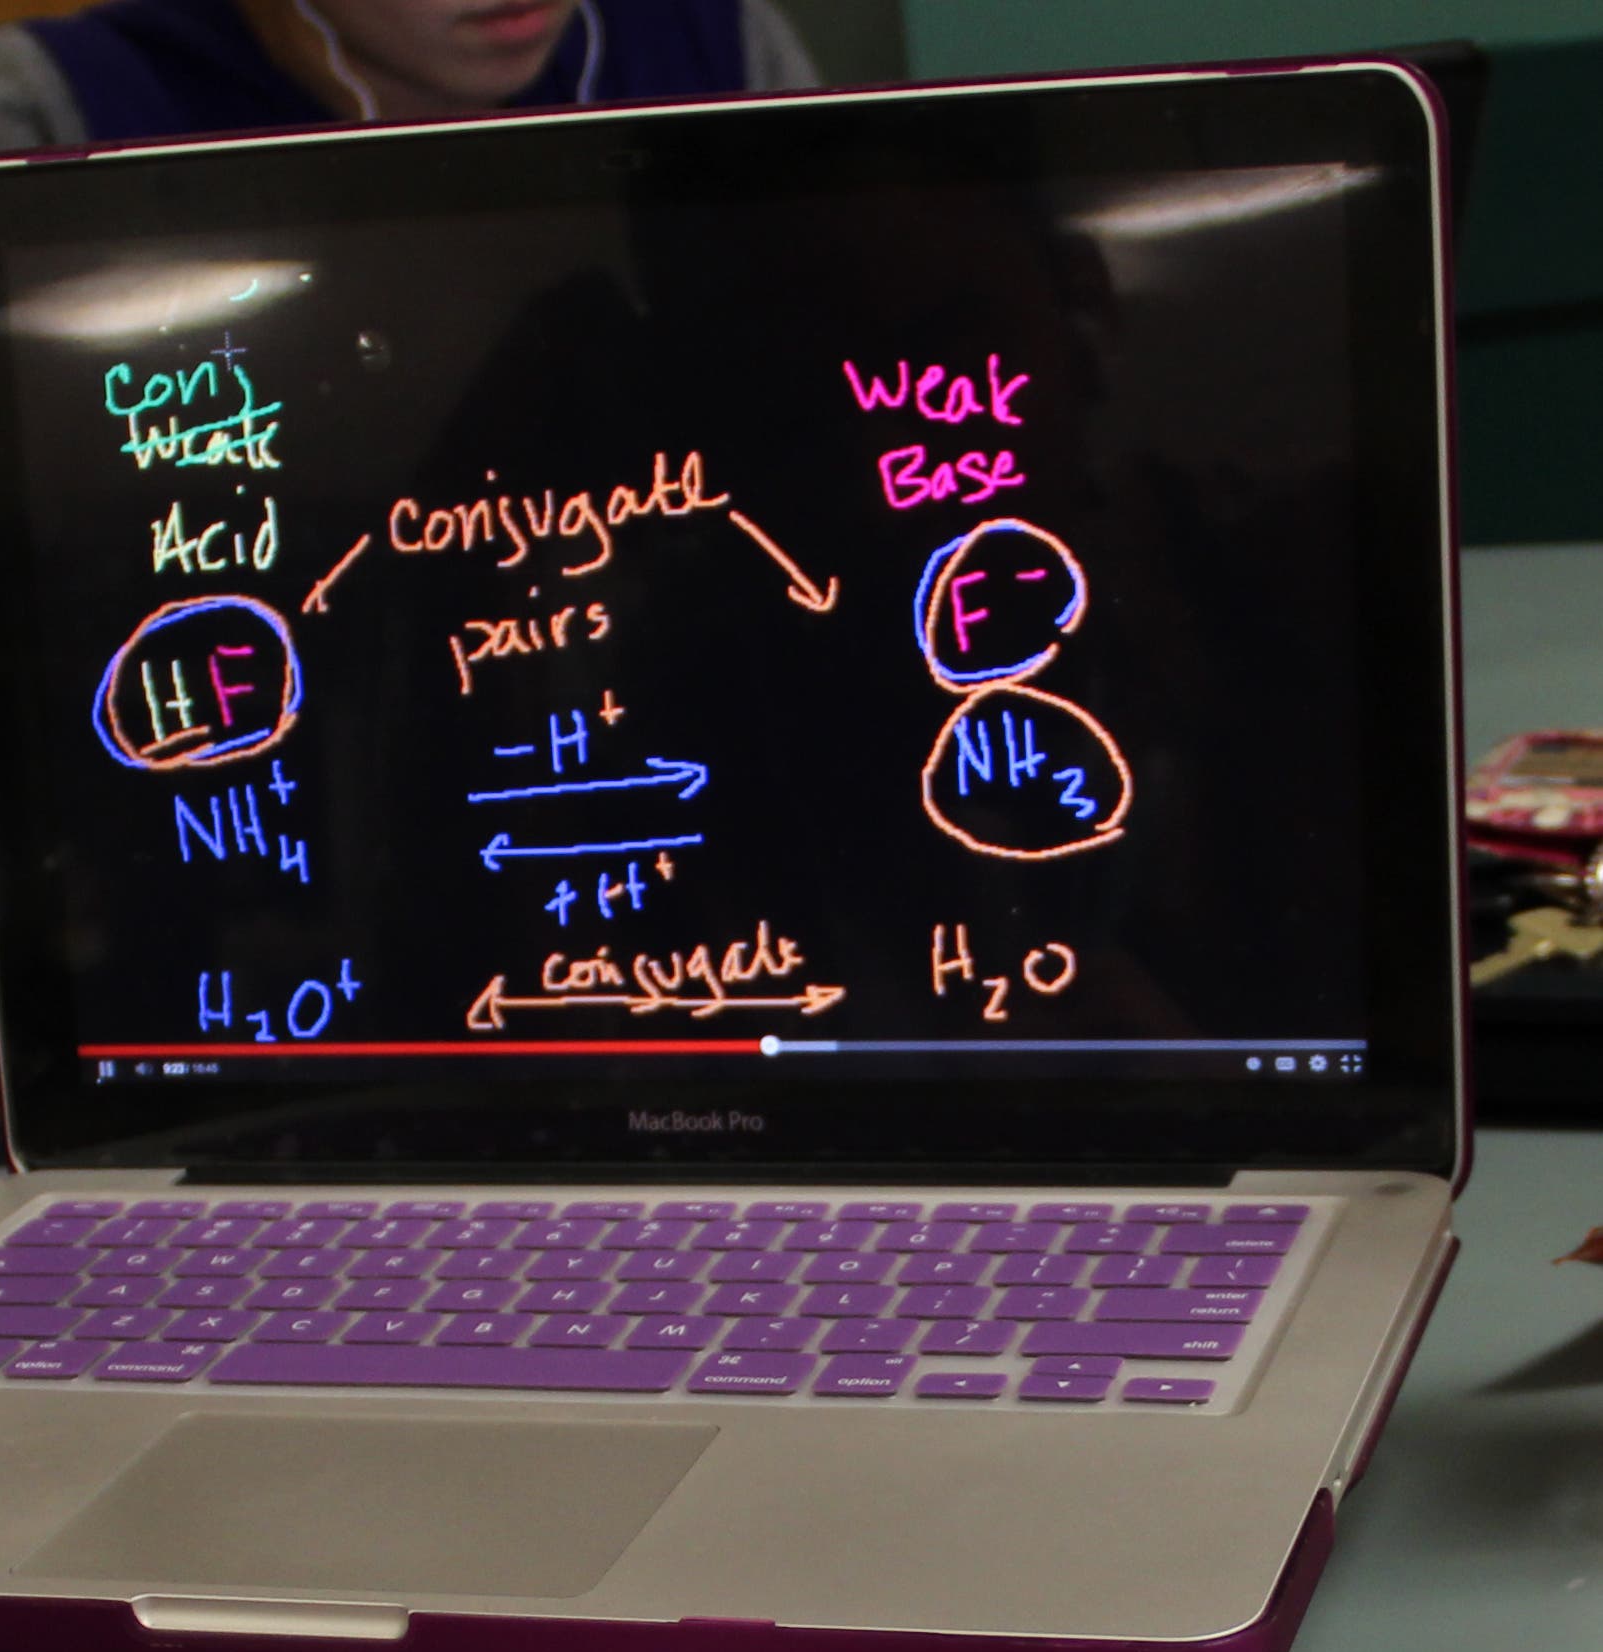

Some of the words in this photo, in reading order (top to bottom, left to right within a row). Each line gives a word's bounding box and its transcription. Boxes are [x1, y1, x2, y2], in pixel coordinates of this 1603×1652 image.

[878, 445, 1026, 508] Base
[151, 484, 278, 575] Acid
[450, 586, 610, 694] pairs
[629, 1110, 724, 1131] MacBook
[728, 1110, 764, 1131] Pro
[15, 1361, 62, 1369] option
[107, 1364, 184, 1373] command
[704, 1375, 787, 1385] command
[837, 1377, 891, 1387] option
